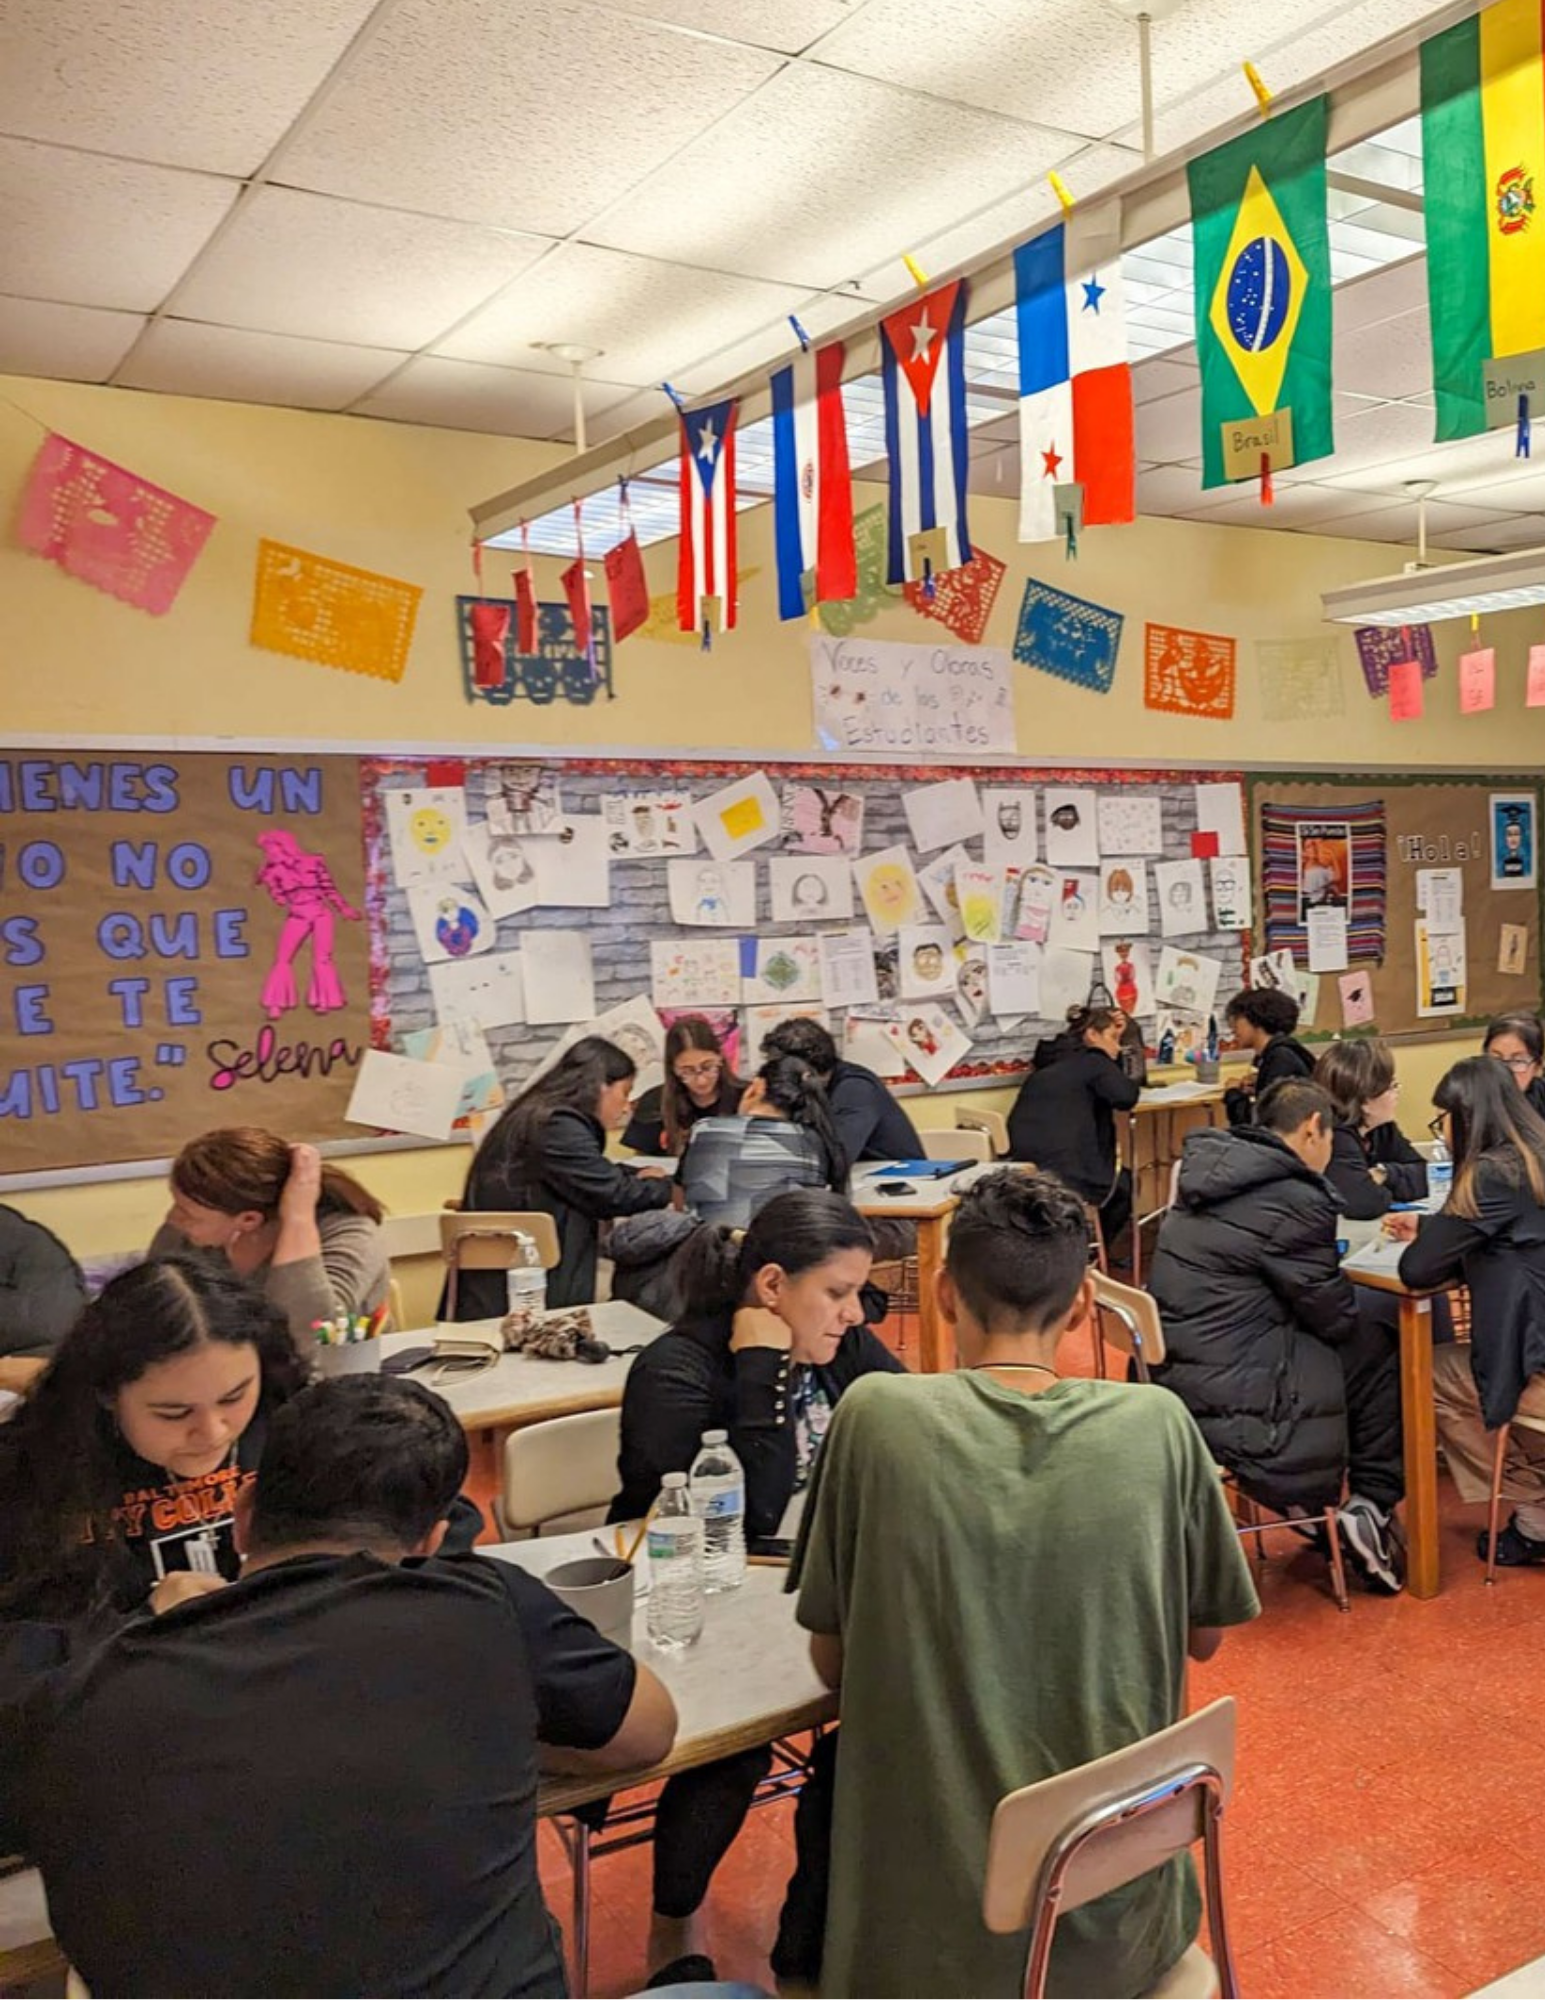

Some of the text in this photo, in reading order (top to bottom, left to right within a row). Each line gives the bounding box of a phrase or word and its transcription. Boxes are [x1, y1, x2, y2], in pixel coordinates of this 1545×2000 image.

[1232, 418, 1278, 453] Brasil
[821, 641, 879, 674] Voces
[228, 765, 323, 815] UN
[112, 840, 211, 890] NO
[2, 908, 250, 966] S QUE
[14, 977, 201, 1035] E TE
[207, 1025, 362, 1090] Selena
